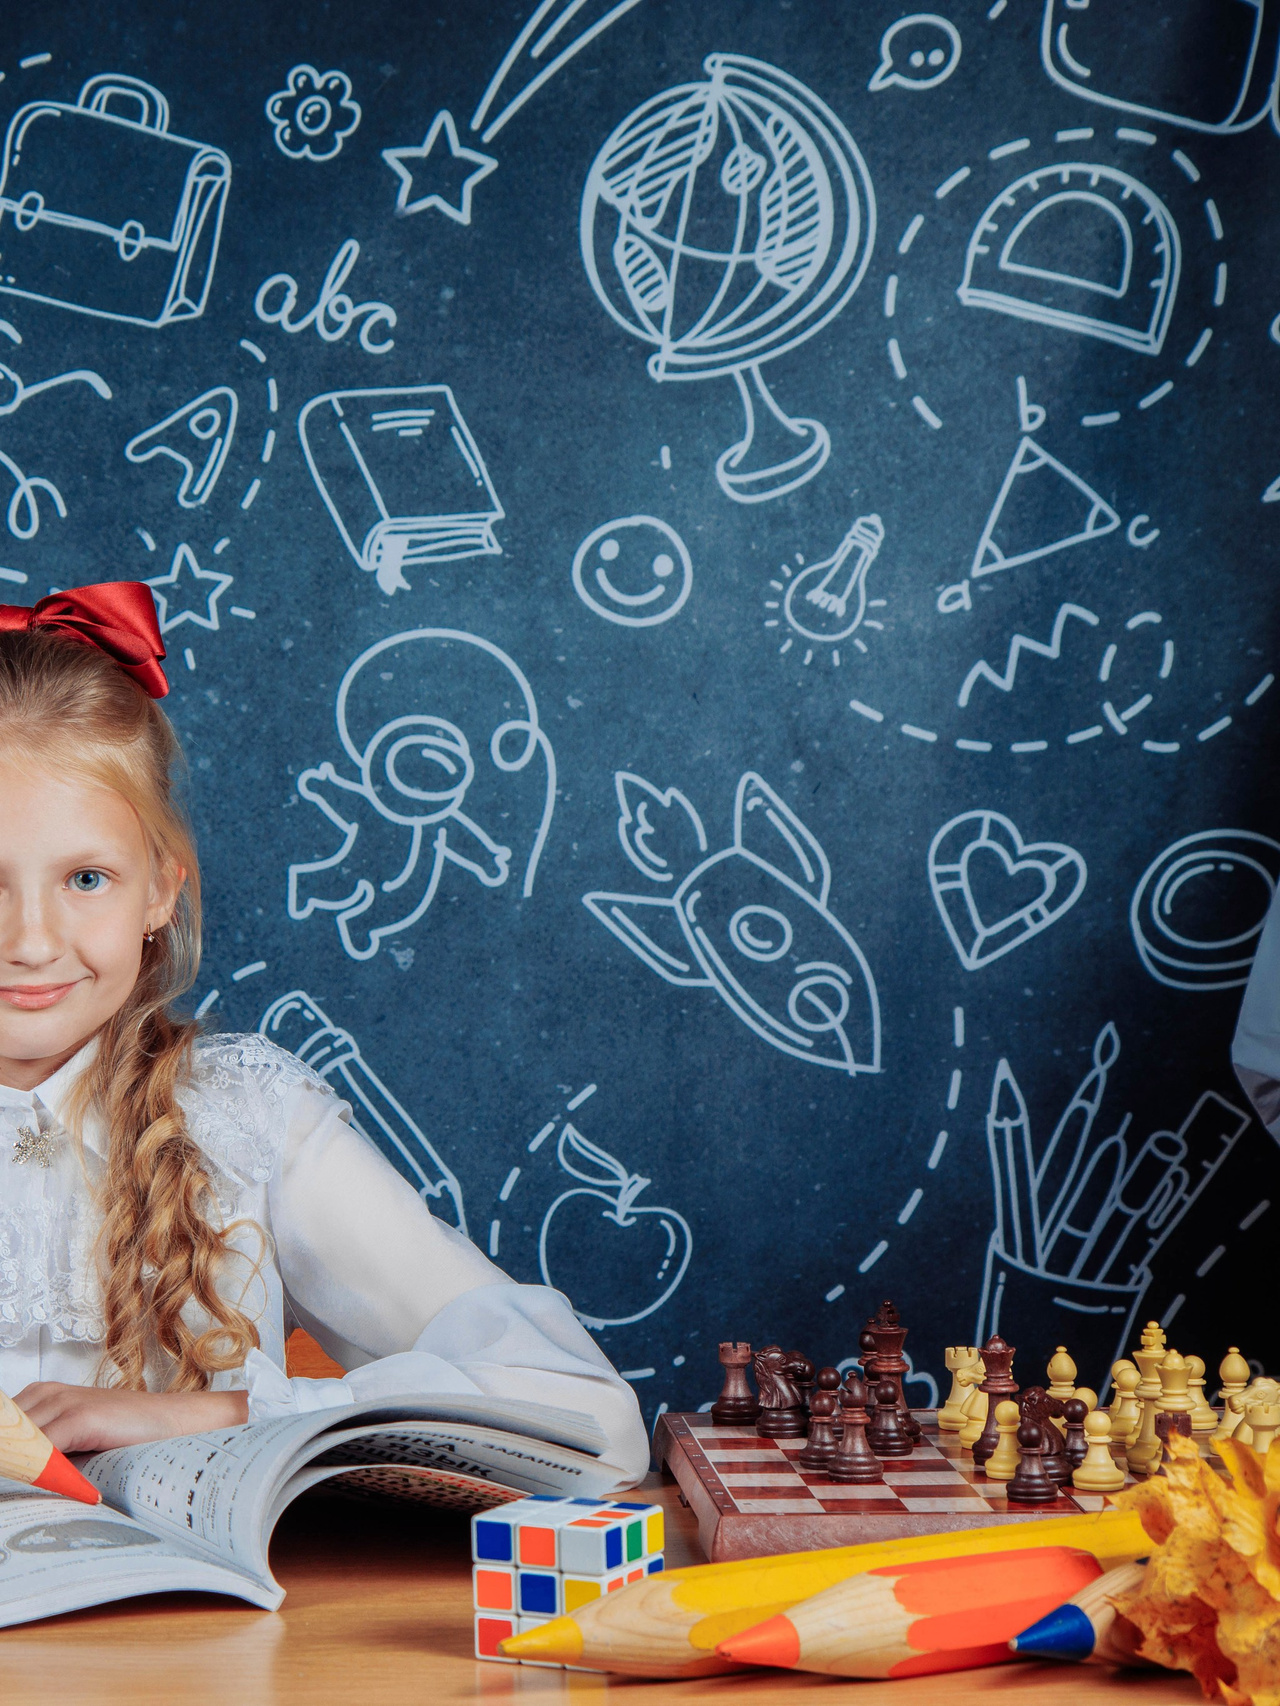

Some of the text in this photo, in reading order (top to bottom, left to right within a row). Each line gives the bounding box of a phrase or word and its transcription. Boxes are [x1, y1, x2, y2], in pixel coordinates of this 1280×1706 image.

[254, 238, 398, 354] abc
[1016, 375, 1047, 432] b
[1127, 514, 1161, 547] c
[937, 579, 972, 613] a
